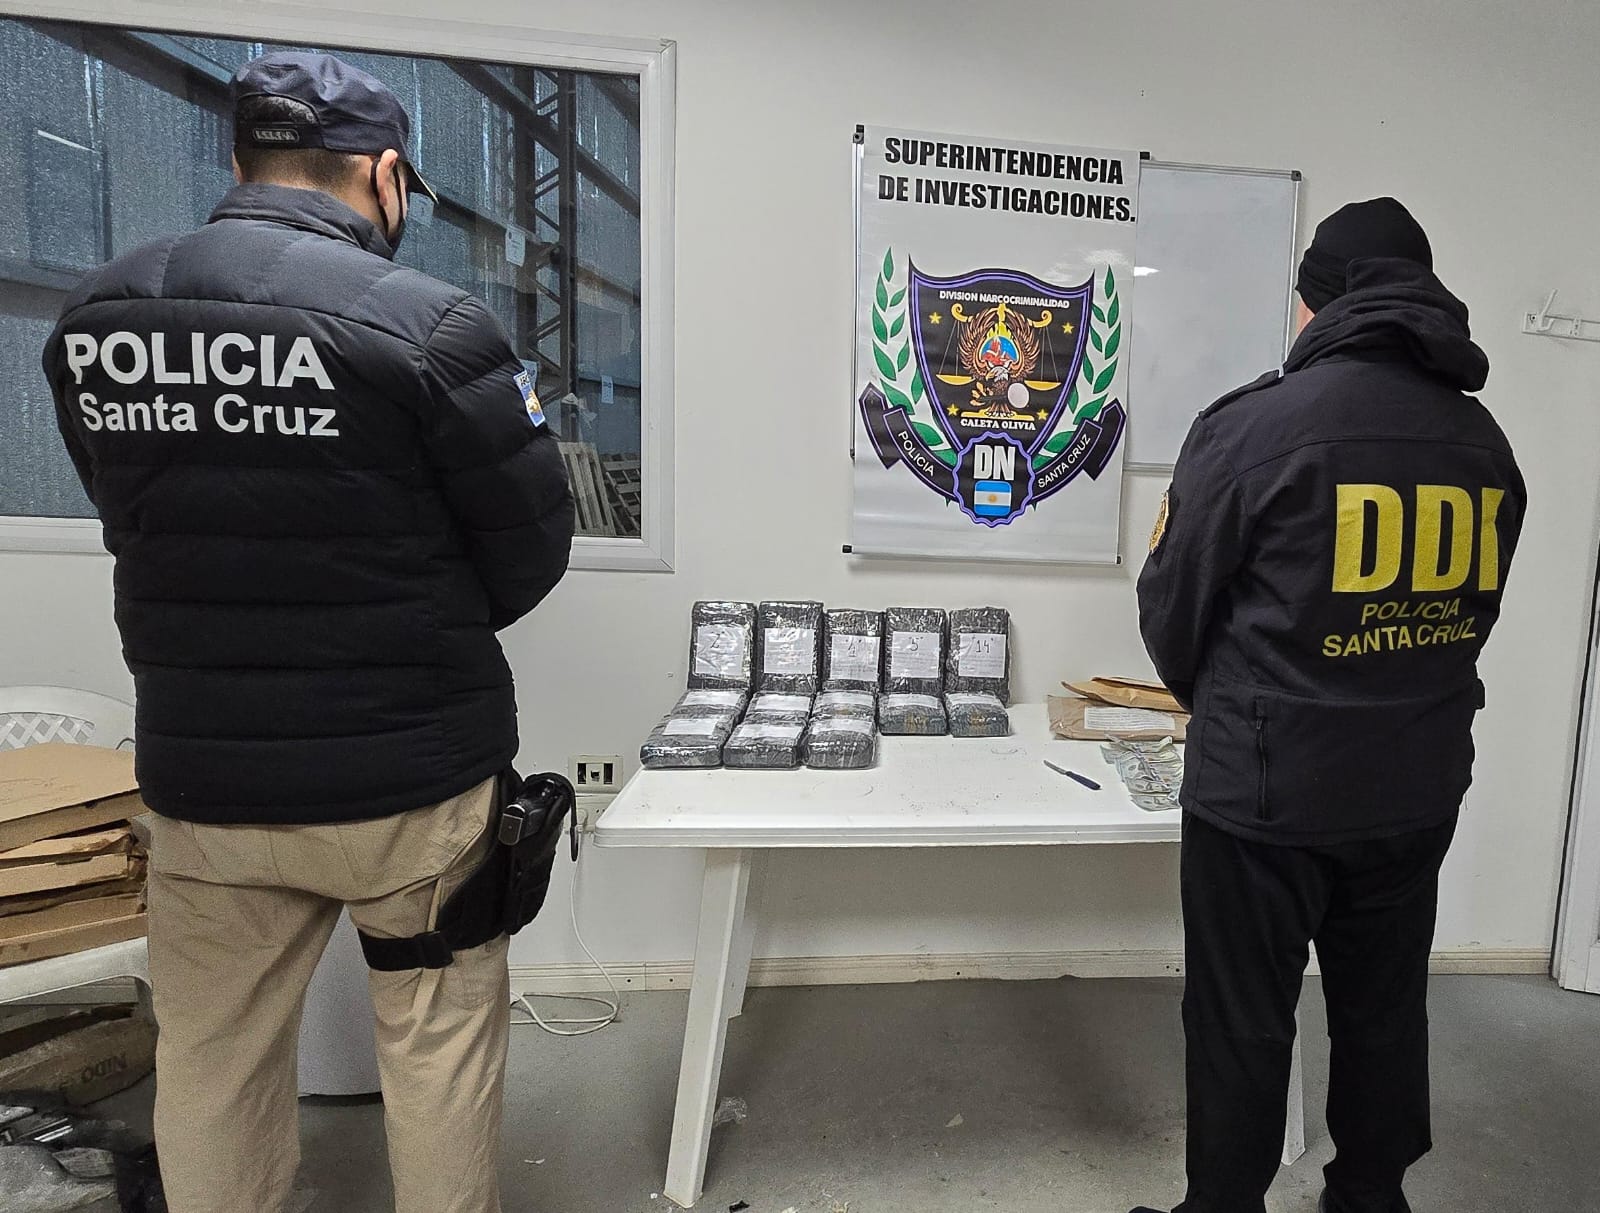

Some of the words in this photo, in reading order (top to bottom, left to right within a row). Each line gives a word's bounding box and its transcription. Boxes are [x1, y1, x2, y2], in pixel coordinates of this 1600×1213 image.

[885, 137, 1123, 185] SUPERINTENDENCIA
[878, 174, 908, 202] DE
[915, 178, 1136, 222] INVESTIGACIONES.
[939, 290, 979, 304] DIVISION
[979, 293, 1070, 309] NARCOCRIMINALIDAD
[64, 331, 336, 390] POLICIA
[78, 392, 198, 432] Santa
[214, 393, 340, 437] Cruz
[960, 418, 999, 430] CALETA
[1002, 420, 1036, 431] OLIVIA
[897, 430, 935, 477] POLICIA
[973, 444, 1016, 481] DN
[1038, 459, 1069, 488] SANTA
[1066, 433, 1092, 464] CRUZ
[1332, 484, 1505, 592] DDI
[1360, 598, 1461, 625] POLICIA
[1321, 625, 1413, 657] SANTA
[1416, 616, 1477, 646] CRUZ
